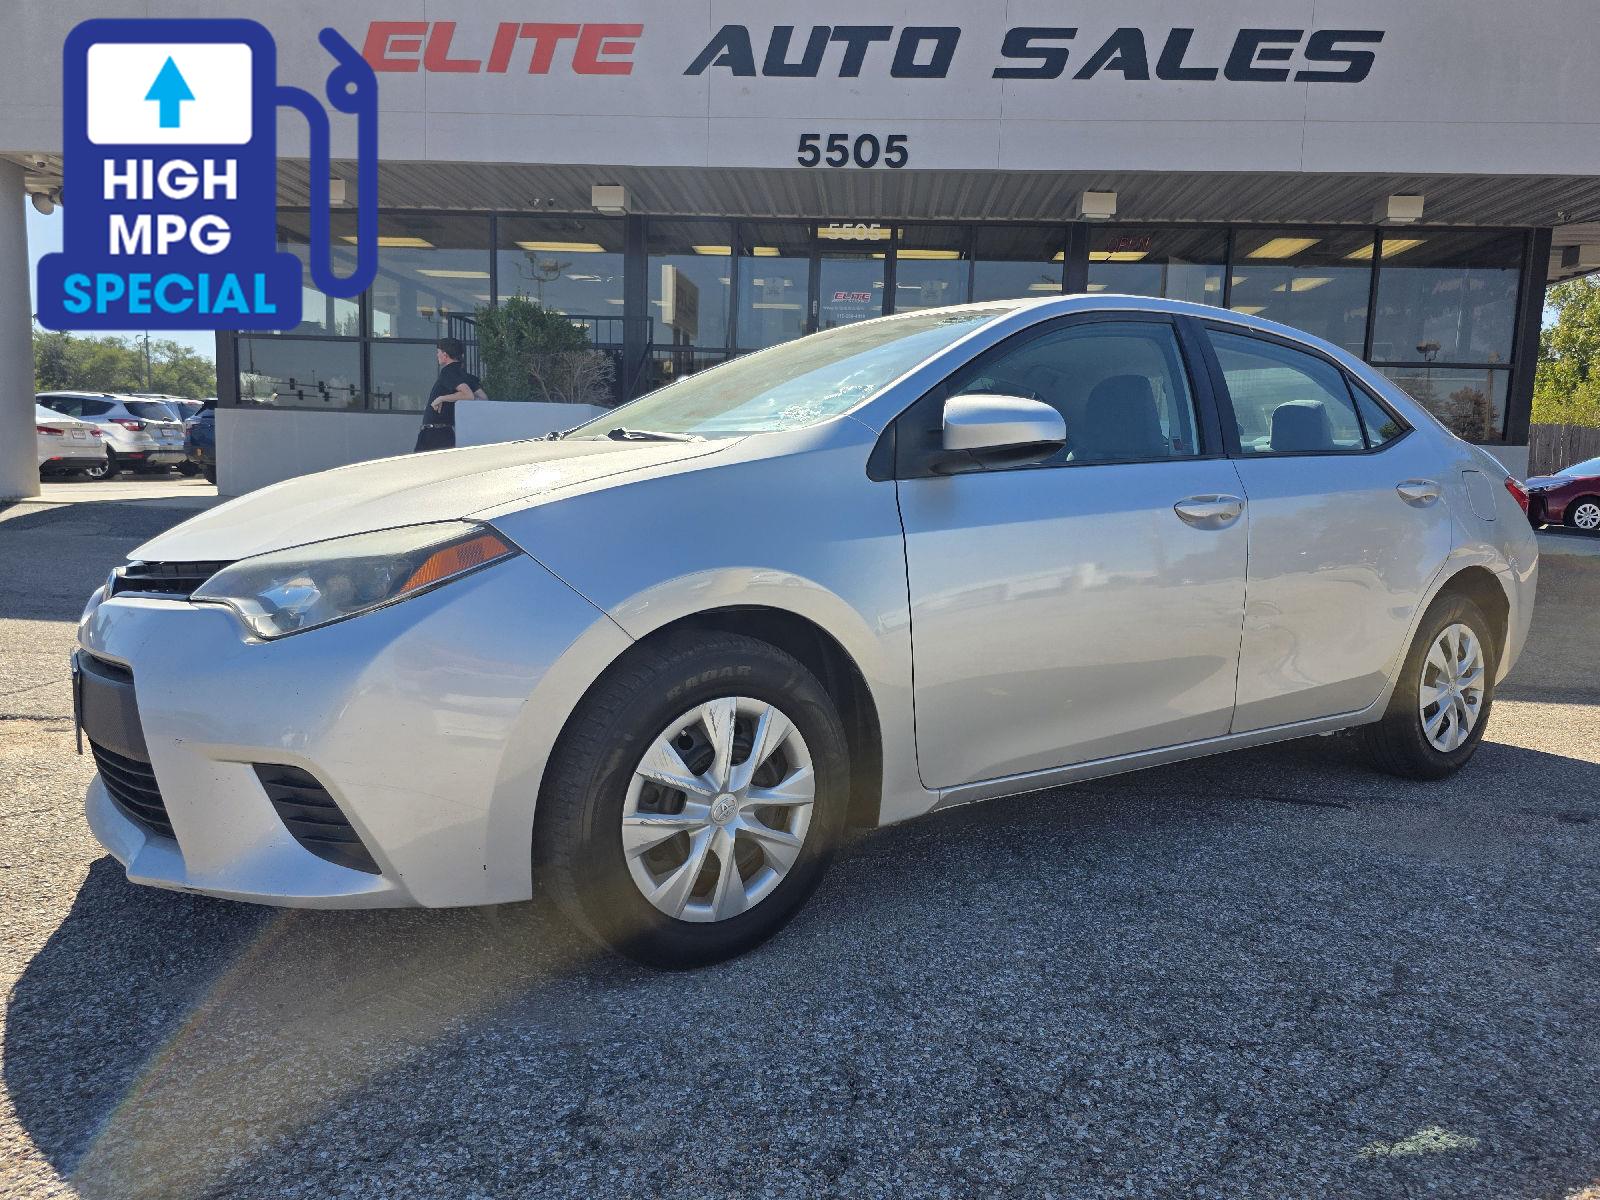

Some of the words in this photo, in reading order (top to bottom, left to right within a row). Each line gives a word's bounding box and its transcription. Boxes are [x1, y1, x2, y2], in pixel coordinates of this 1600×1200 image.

[363, 22, 644, 75] ELITE
[683, 25, 962, 79] AUTO
[992, 27, 1385, 83] SALES
[797, 133, 909, 170] 5505
[828, 223, 881, 241] 5505
[834, 291, 871, 300] ELITE
